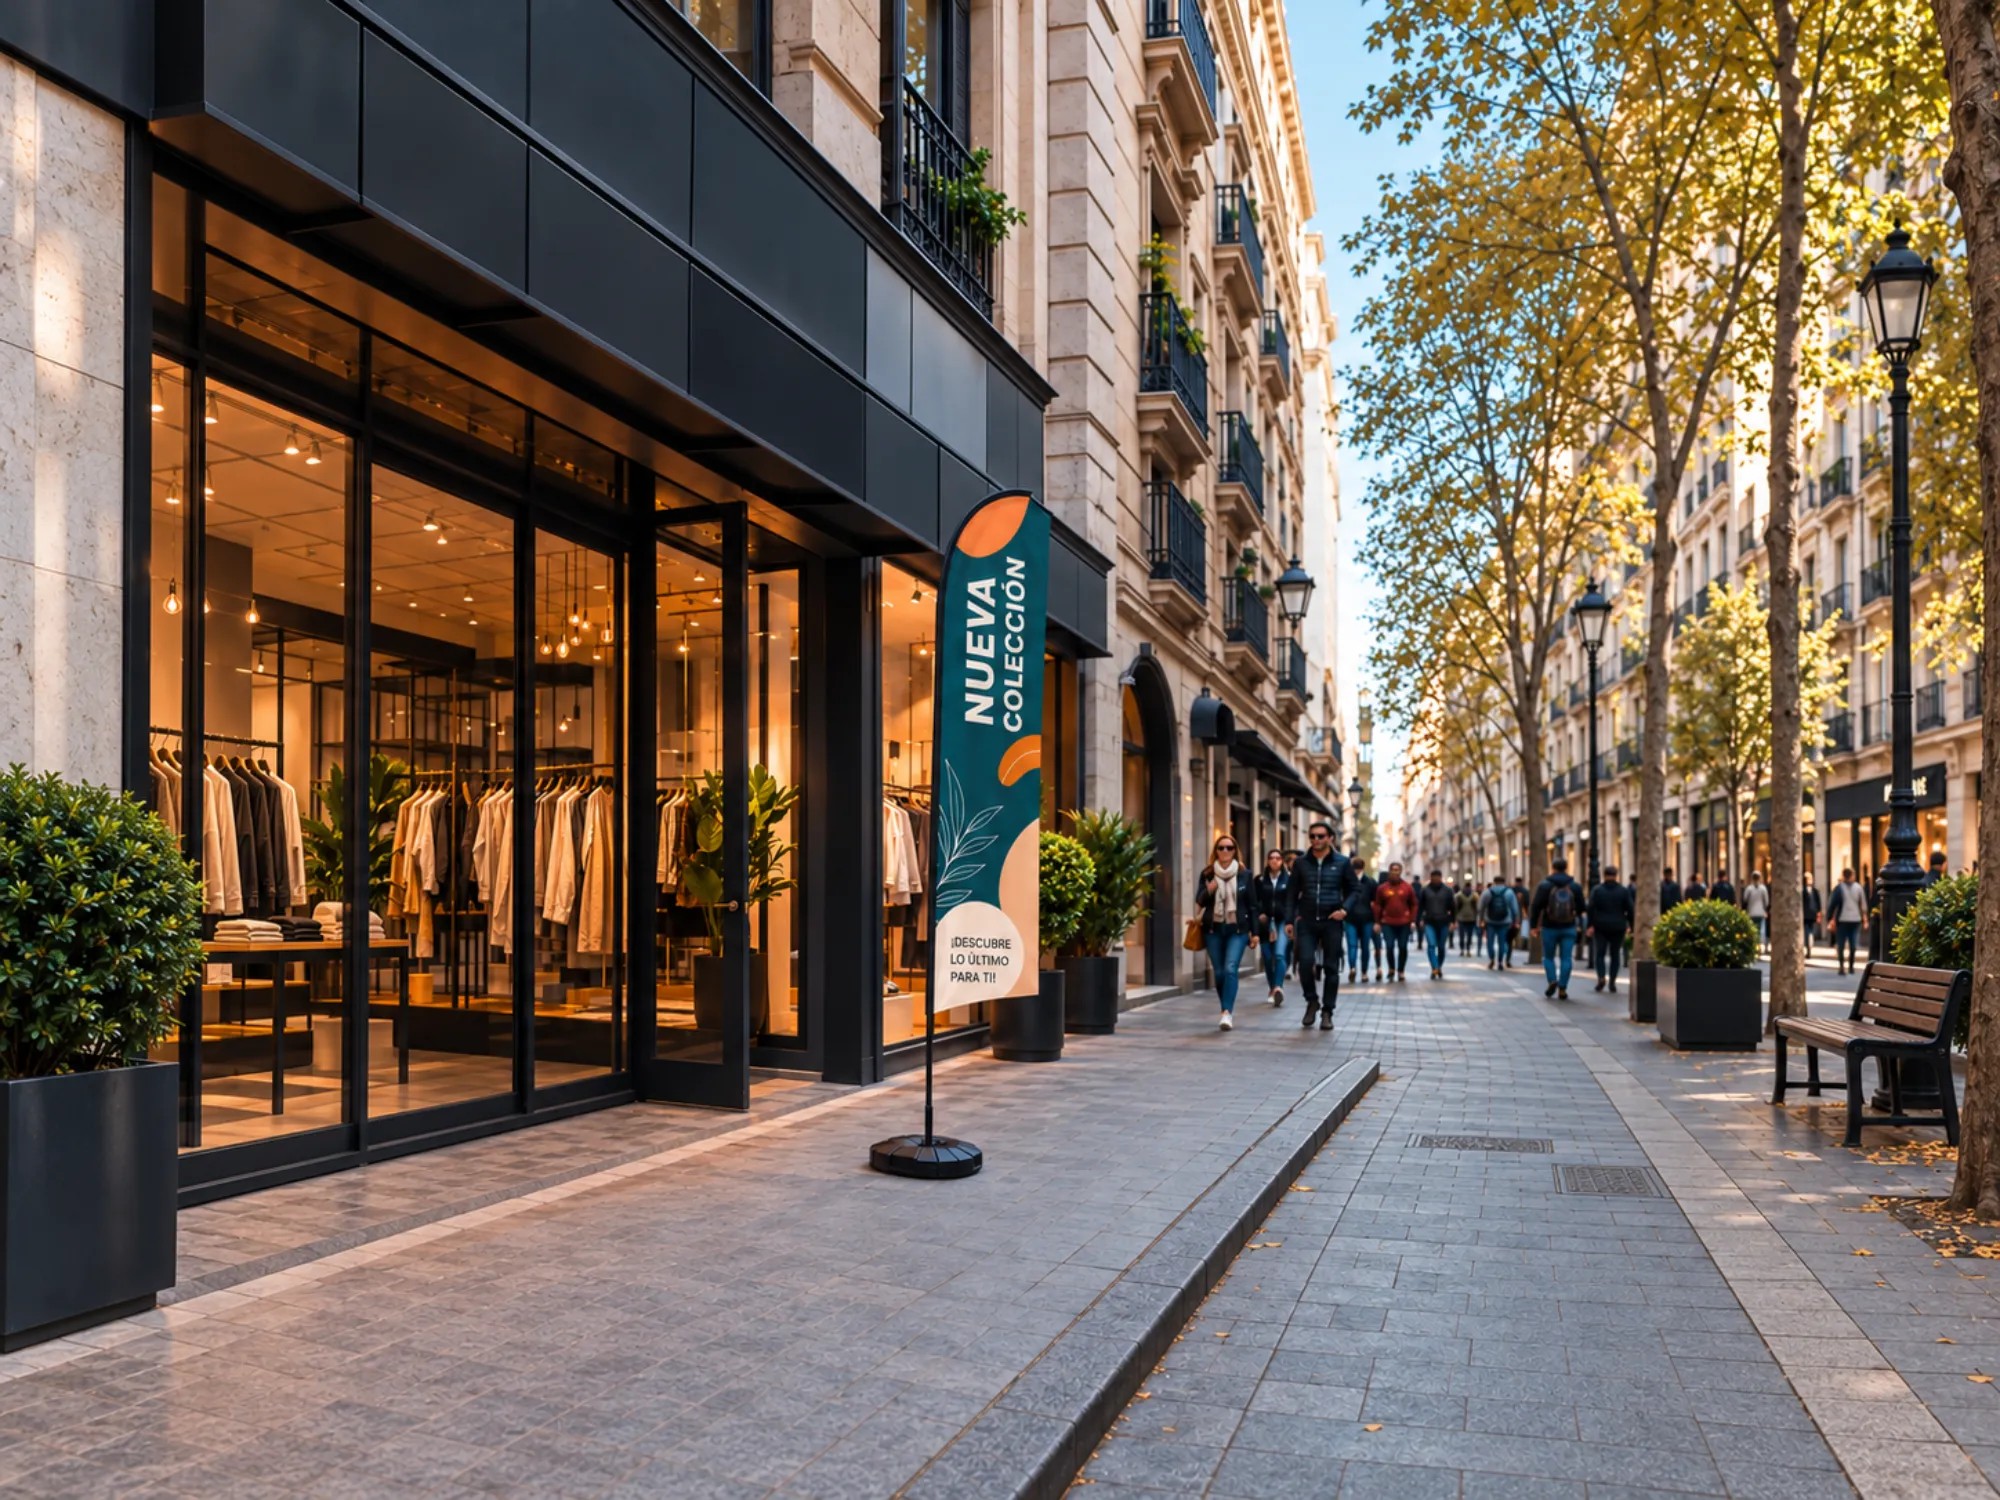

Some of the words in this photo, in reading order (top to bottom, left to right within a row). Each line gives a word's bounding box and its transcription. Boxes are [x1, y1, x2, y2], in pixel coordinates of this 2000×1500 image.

[964, 577, 997, 726] NUEVA
[1001, 556, 1026, 733] COLECCIÓN
[951, 936, 1012, 949] ¡DESCUBRE
[950, 953, 965, 965] LO
[968, 951, 1009, 966] ÚLTIMO
[950, 971, 980, 983] PARA
[983, 972, 996, 983] TI!
